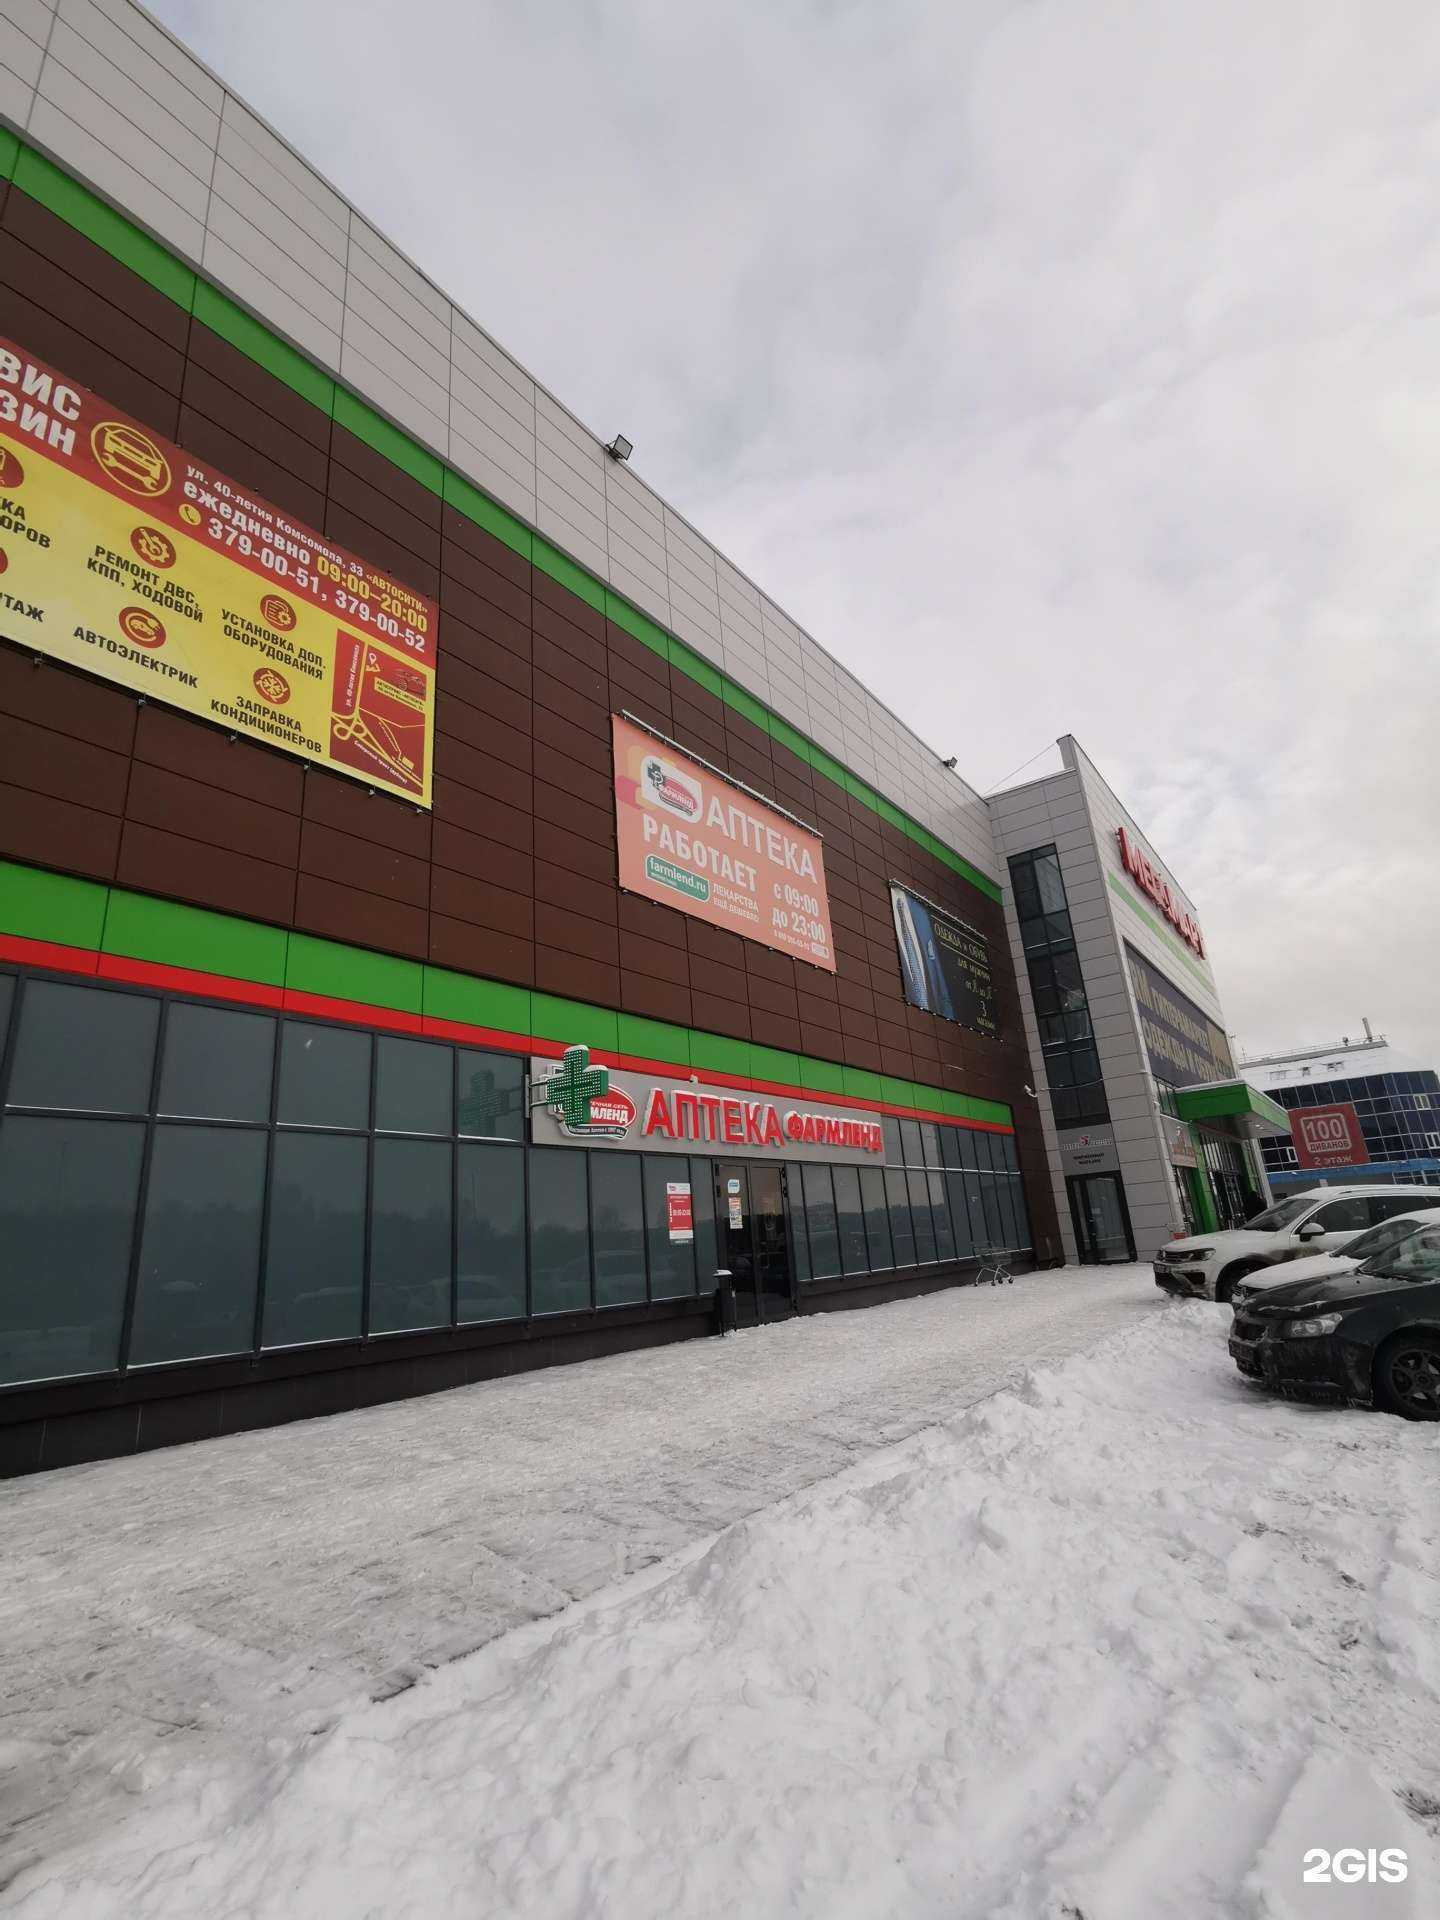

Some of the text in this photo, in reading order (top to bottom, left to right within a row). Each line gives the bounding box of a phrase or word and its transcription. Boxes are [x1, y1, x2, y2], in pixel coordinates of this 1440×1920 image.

[0, 496, 25, 520] КА
[183, 481, 311, 565] ежедневно
[187, 465, 209, 485] ул.
[213, 481, 273, 523] 40-летия
[276, 517, 346, 569] Комсомола,
[350, 562, 364, 577] 33
[87, 557, 203, 623] КПП, ХОДОВОЙ
[94, 545, 201, 608] РЕМОНТ ДВС,
[208, 517, 426, 653] 379-00-51, 379-00-52
[0, 592, 44, 622] ТАЖ
[73, 626, 199, 689] АВТОЭЛЕКТРИК
[221, 608, 326, 669] УСТАНОВКА ДОП.
[223, 624, 323, 681] ОБОРУДОВАНИЯ
[210, 699, 322, 754] КОНДИЦИОНЕРОВ
[236, 696, 302, 732] ЗАПРАВКА
[642, 813, 757, 893] РАБОТАЕТ
[705, 795, 818, 885] АПТЕКА
[649, 857, 707, 893] farmlend.ru
[784, 884, 819, 917] 09:00
[791, 911, 826, 944] 23:00
[590, 1107, 628, 1123] МЛЕНД
[641, 1088, 883, 1153] АПТЕКА ФАРМЛЕНД
[1306, 1118, 1343, 1140] 100
